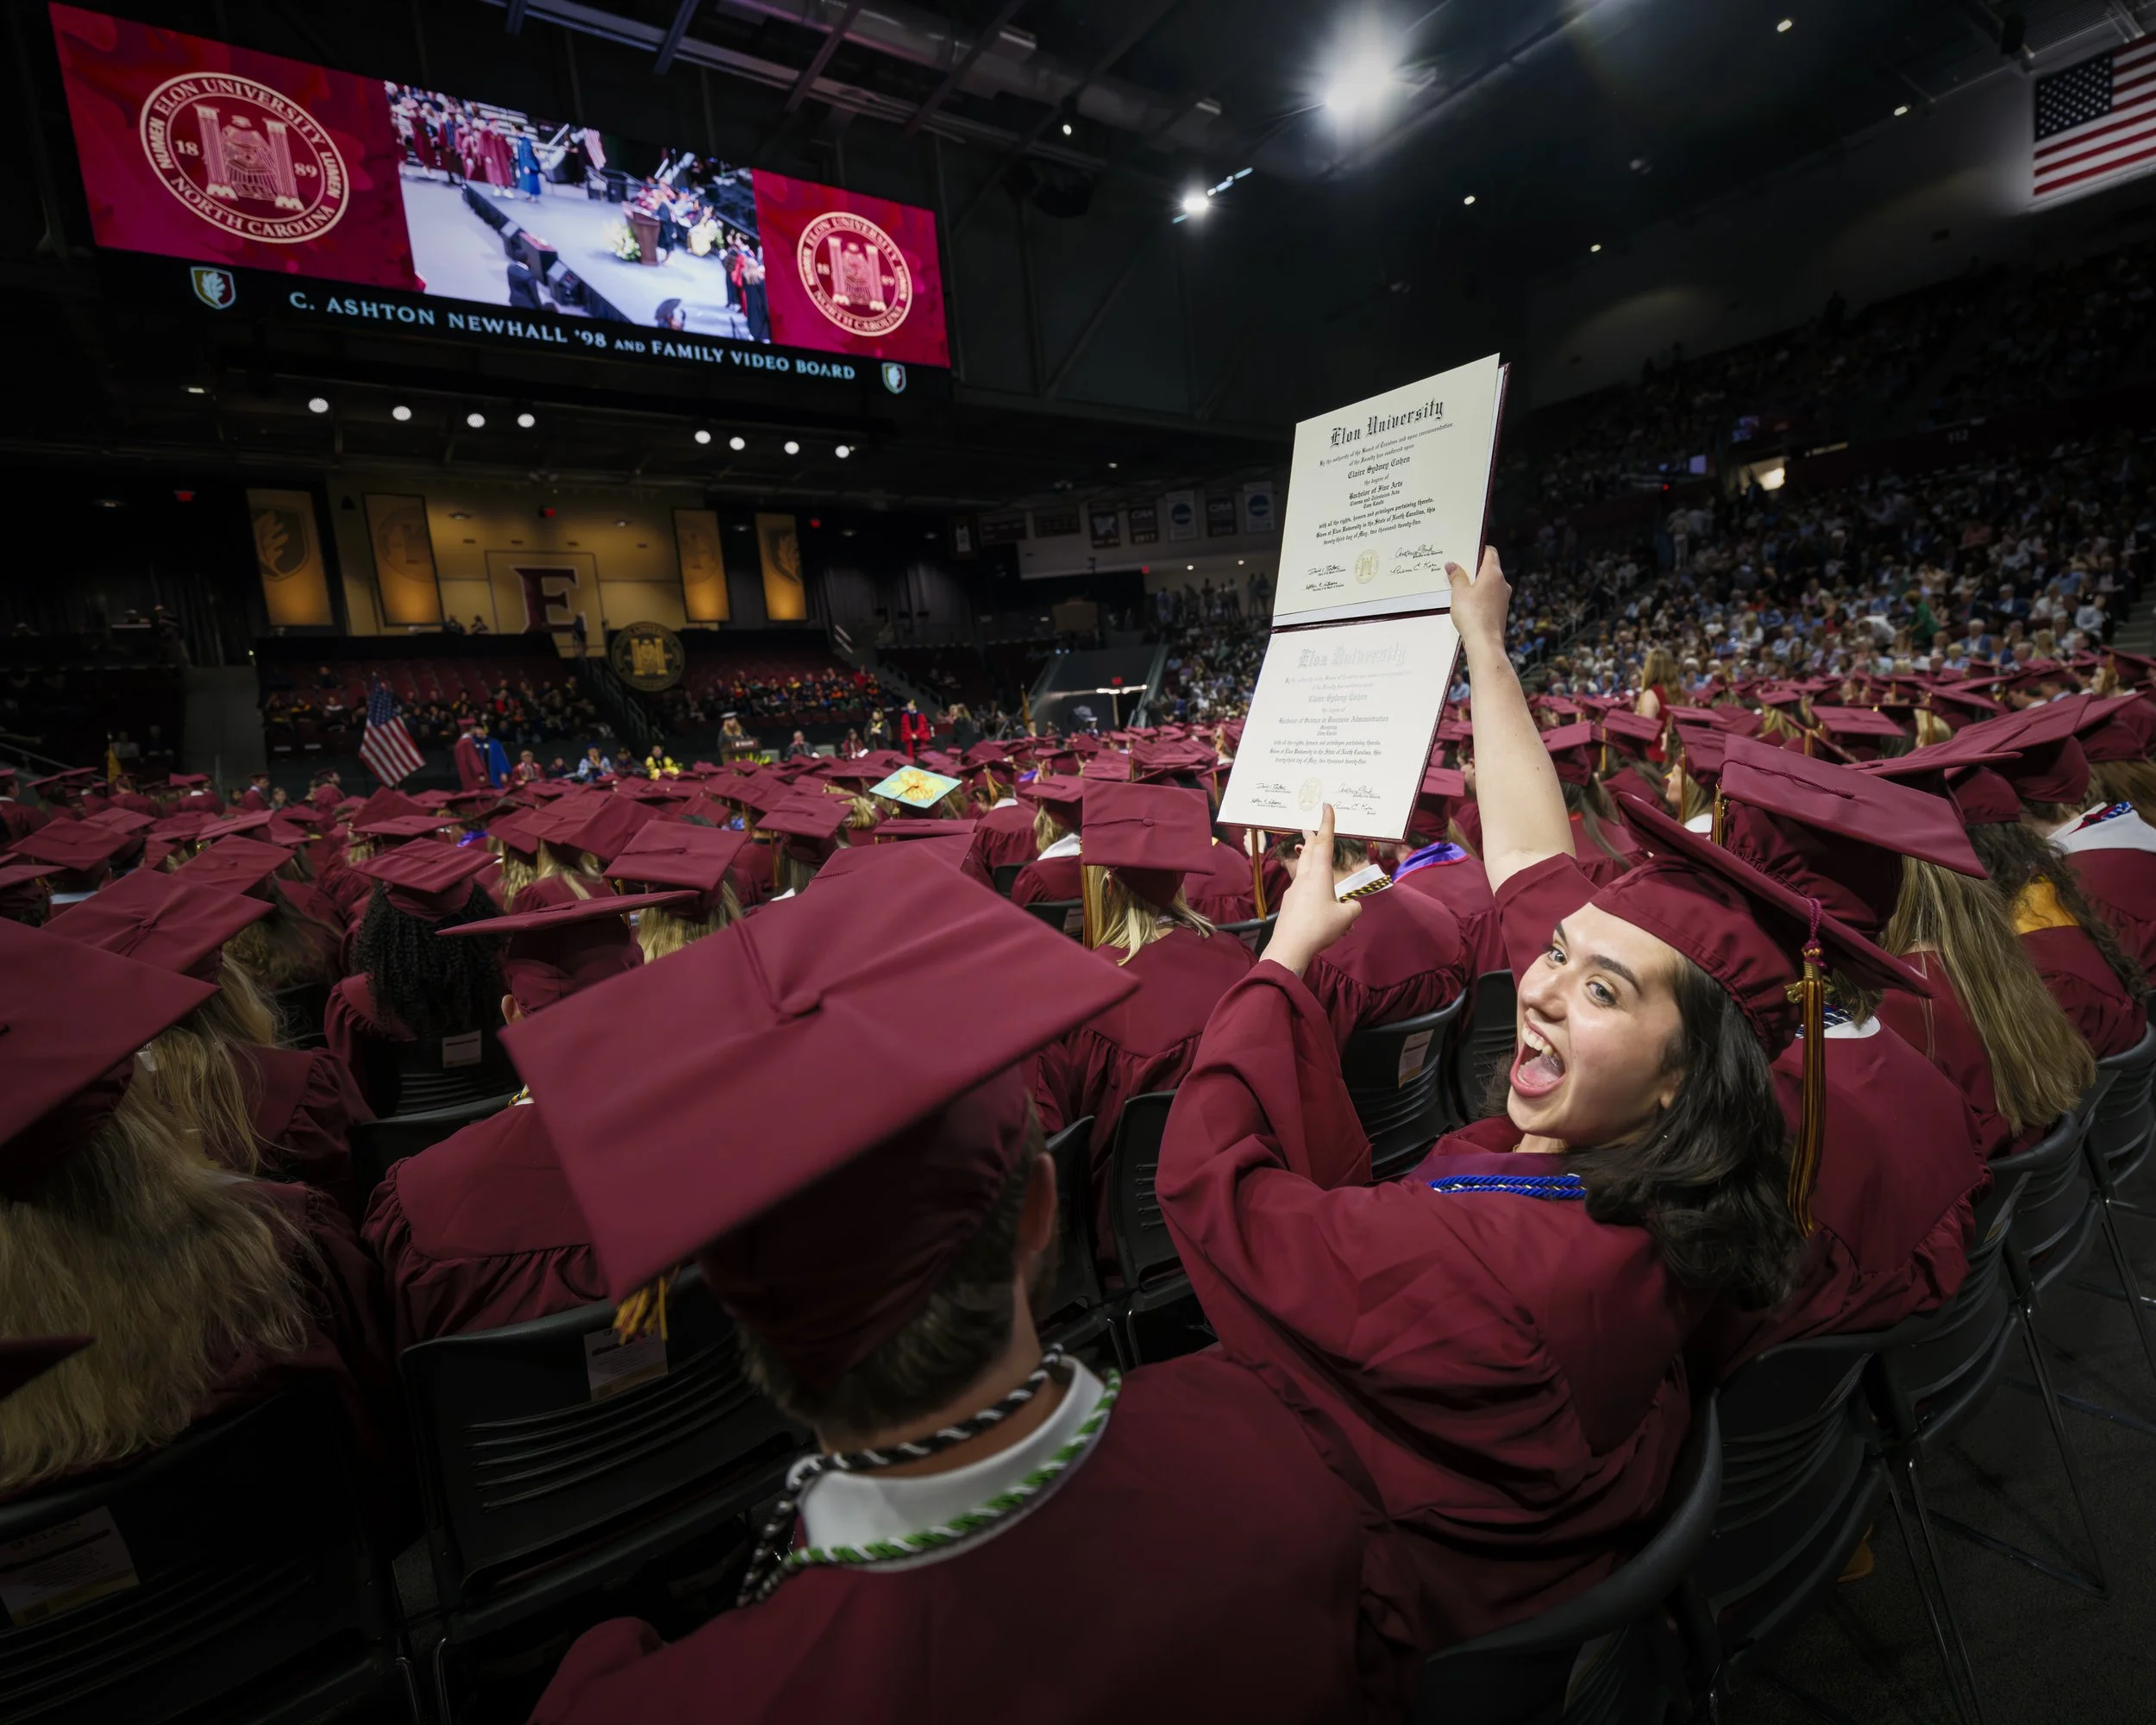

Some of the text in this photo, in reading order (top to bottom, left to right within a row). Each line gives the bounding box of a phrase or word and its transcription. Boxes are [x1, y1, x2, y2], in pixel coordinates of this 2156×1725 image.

[154, 78, 327, 146] ELON UNIVERSITY
[149, 116, 175, 170] NUMEN
[174, 139, 200, 157] 18
[293, 161, 318, 179] 89
[320, 151, 342, 200] LUMEN
[171, 176, 336, 238] NORTH CAROLINA
[289, 291, 856, 380] C. ASHTON NEWHALL '98 AND FAMILY VIDEO BOARD
[1330, 398, 1444, 448] Elon University
[1347, 455, 1411, 480] Claire Sydney Cohen
[1349, 489, 1369, 500] Bachelor
[1377, 484, 1389, 493] Fine
[1391, 480, 1402, 490] Arts
[1342, 523, 1362, 533] University
[1392, 514, 1405, 523] North
[509, 566, 589, 636] E
[1297, 649, 1328, 669] Elon
